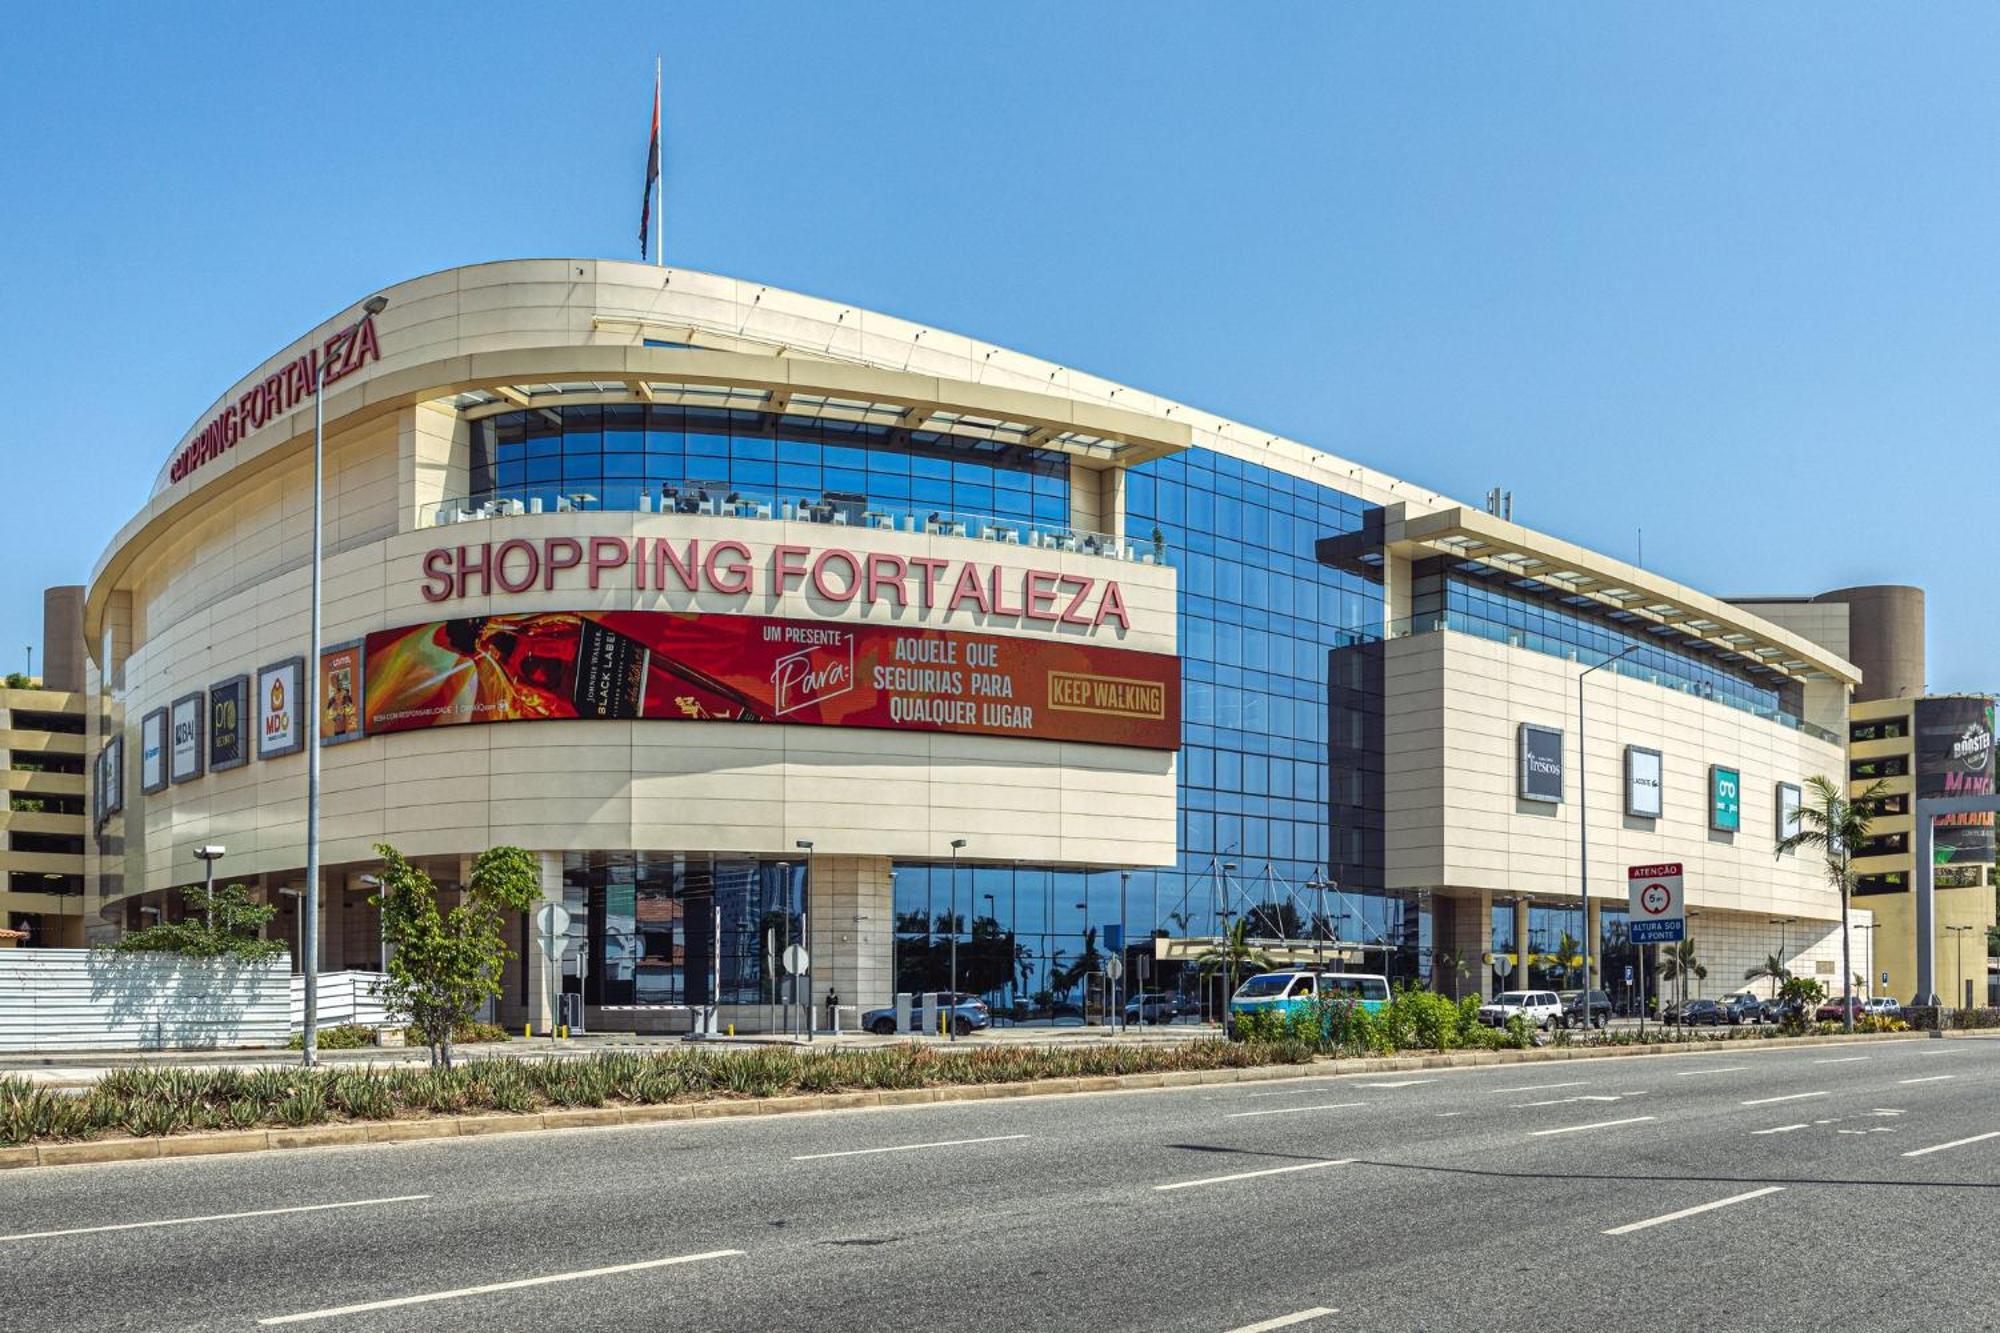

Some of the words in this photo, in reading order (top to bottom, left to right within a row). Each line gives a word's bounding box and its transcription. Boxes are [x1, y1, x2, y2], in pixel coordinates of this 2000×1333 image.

[240, 317, 380, 438] FORTALEZA
[422, 537, 753, 602] SHOPPING
[775, 545, 1130, 629] FORTALEZA
[763, 626, 782, 641] UM
[785, 627, 841, 646] PRESENTE
[895, 637, 957, 664] AQUELE
[966, 642, 998, 668] QUE
[598, 672, 611, 715] BLACK
[873, 665, 962, 694] SEGUIRIAS
[971, 672, 1013, 698] PARA
[1053, 677, 1091, 705] KEEP
[1094, 682, 1160, 713] WALKING
[890, 697, 976, 725] QUALQUER
[983, 703, 1032, 729] LUGAR
[1634, 865, 1677, 877] ATENÇÃO
[1649, 894, 1656, 903] 5
[1633, 922, 1662, 931] ALTURA
[1664, 921, 1681, 930] SOB
[1640, 932, 1646, 940] A
[1648, 931, 1674, 940] PONTE
